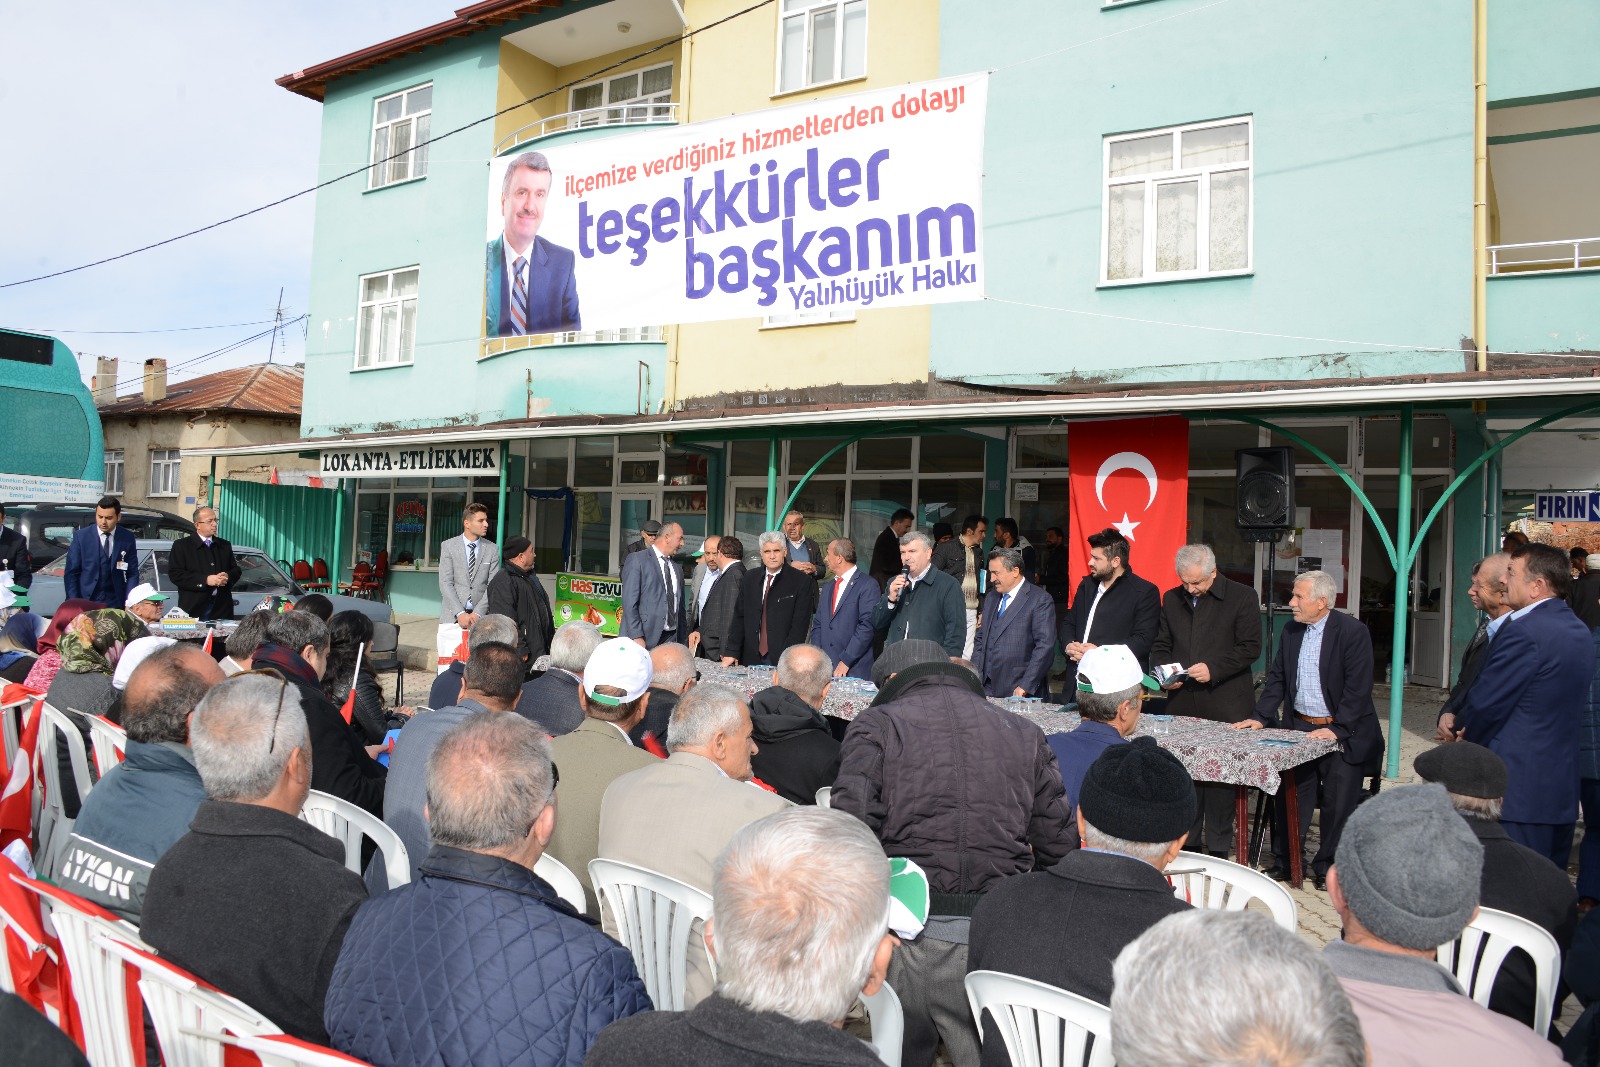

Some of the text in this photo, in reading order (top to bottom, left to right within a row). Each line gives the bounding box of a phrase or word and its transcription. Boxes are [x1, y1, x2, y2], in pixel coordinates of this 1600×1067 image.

[565, 86, 965, 198] ilçemize verdiğiniz hizmetlerden dolayı
[579, 147, 890, 267] teşekkürler
[685, 203, 976, 307] başkanım
[788, 259, 977, 310] Yalıhüyük Halkı
[1538, 495, 1586, 519] FIRIN
